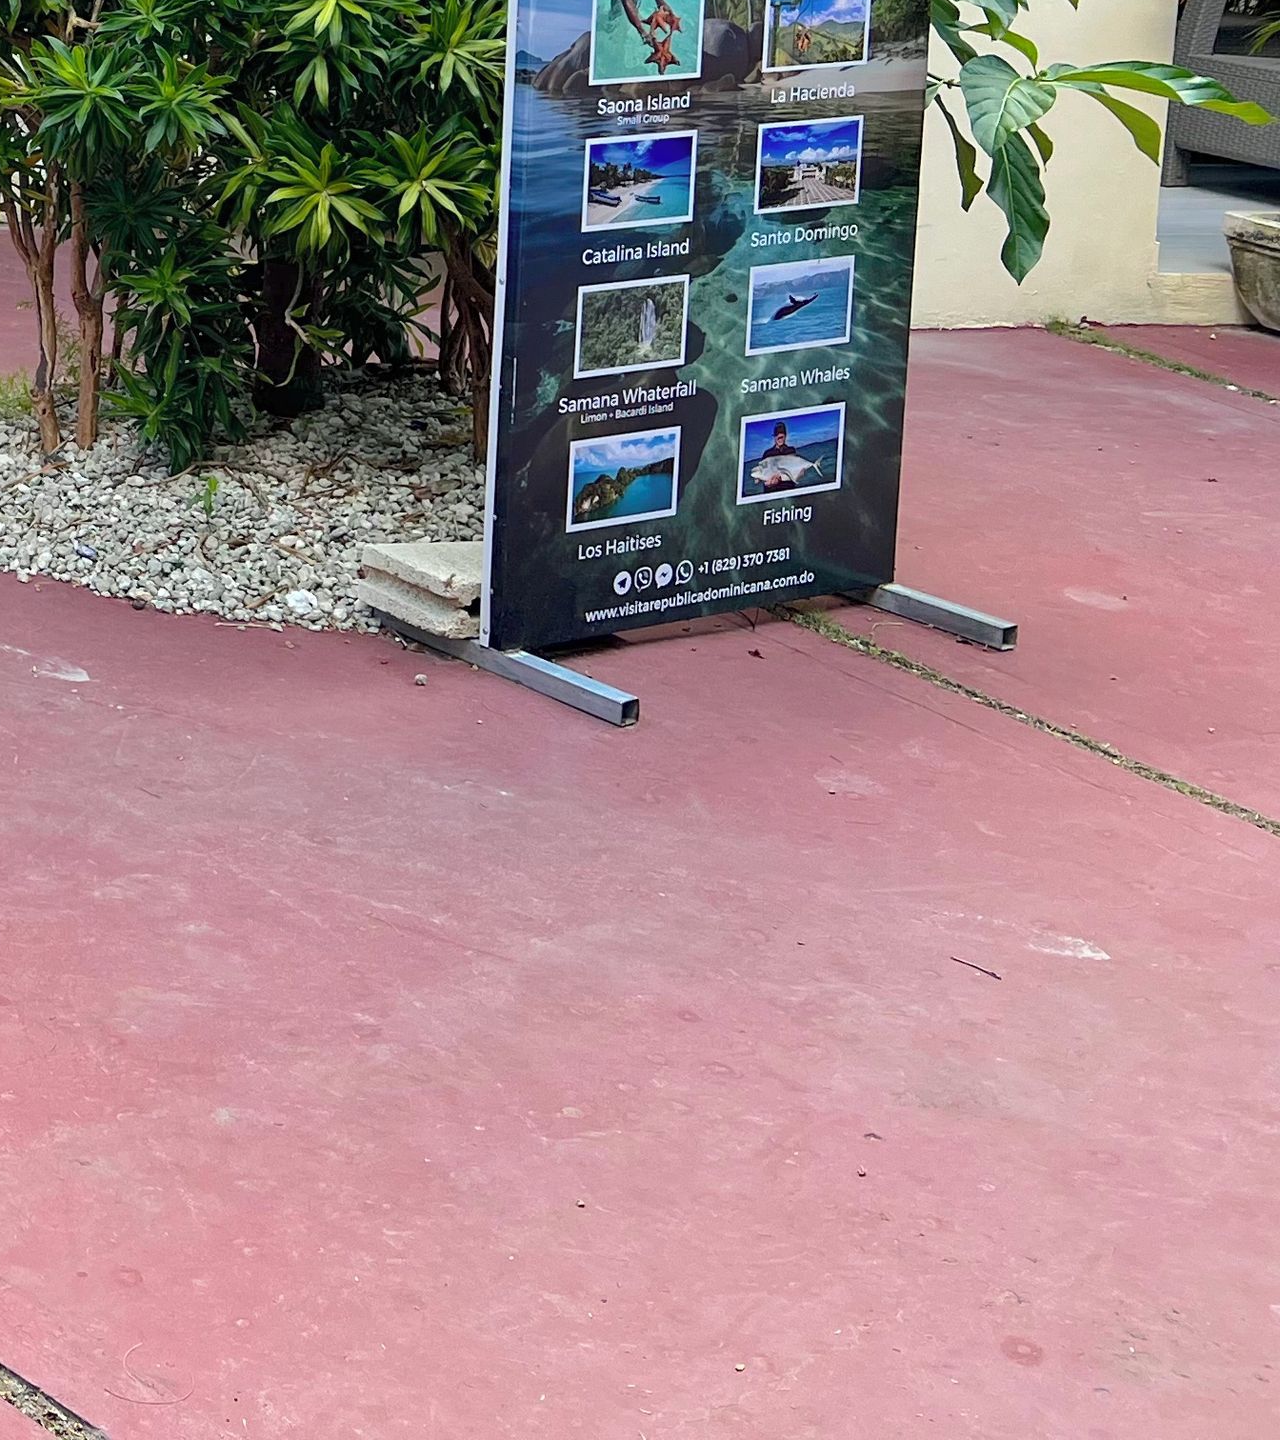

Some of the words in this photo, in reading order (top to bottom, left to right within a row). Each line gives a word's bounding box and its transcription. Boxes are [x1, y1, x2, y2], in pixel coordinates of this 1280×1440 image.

[597, 97, 642, 115] Saona
[646, 91, 691, 111] Island
[771, 88, 786, 104] La
[790, 82, 855, 101] Hacienda
[617, 115, 641, 126] Small
[643, 113, 670, 125] Group
[750, 233, 791, 247] Santo
[794, 223, 859, 243] Domingo
[582, 245, 643, 266] Catalina
[646, 237, 690, 257] Island
[741, 376, 797, 395] Samana
[800, 366, 851, 386] Whales
[558, 393, 619, 414] Samana
[622, 379, 697, 405] Whaterfall
[580, 412, 608, 424] Limon
[615, 405, 647, 419] Bacardi
[648, 402, 674, 414] Island
[763, 505, 812, 526] Fishing
[577, 543, 602, 560] Los
[605, 534, 662, 556] Haitises
[698, 561, 709, 574] +1
[711, 557, 741, 575] (829)
[742, 553, 764, 567] 370
[766, 548, 790, 562] 7381
[585, 570, 815, 622] www.visitarepublicadominicana.com.do
